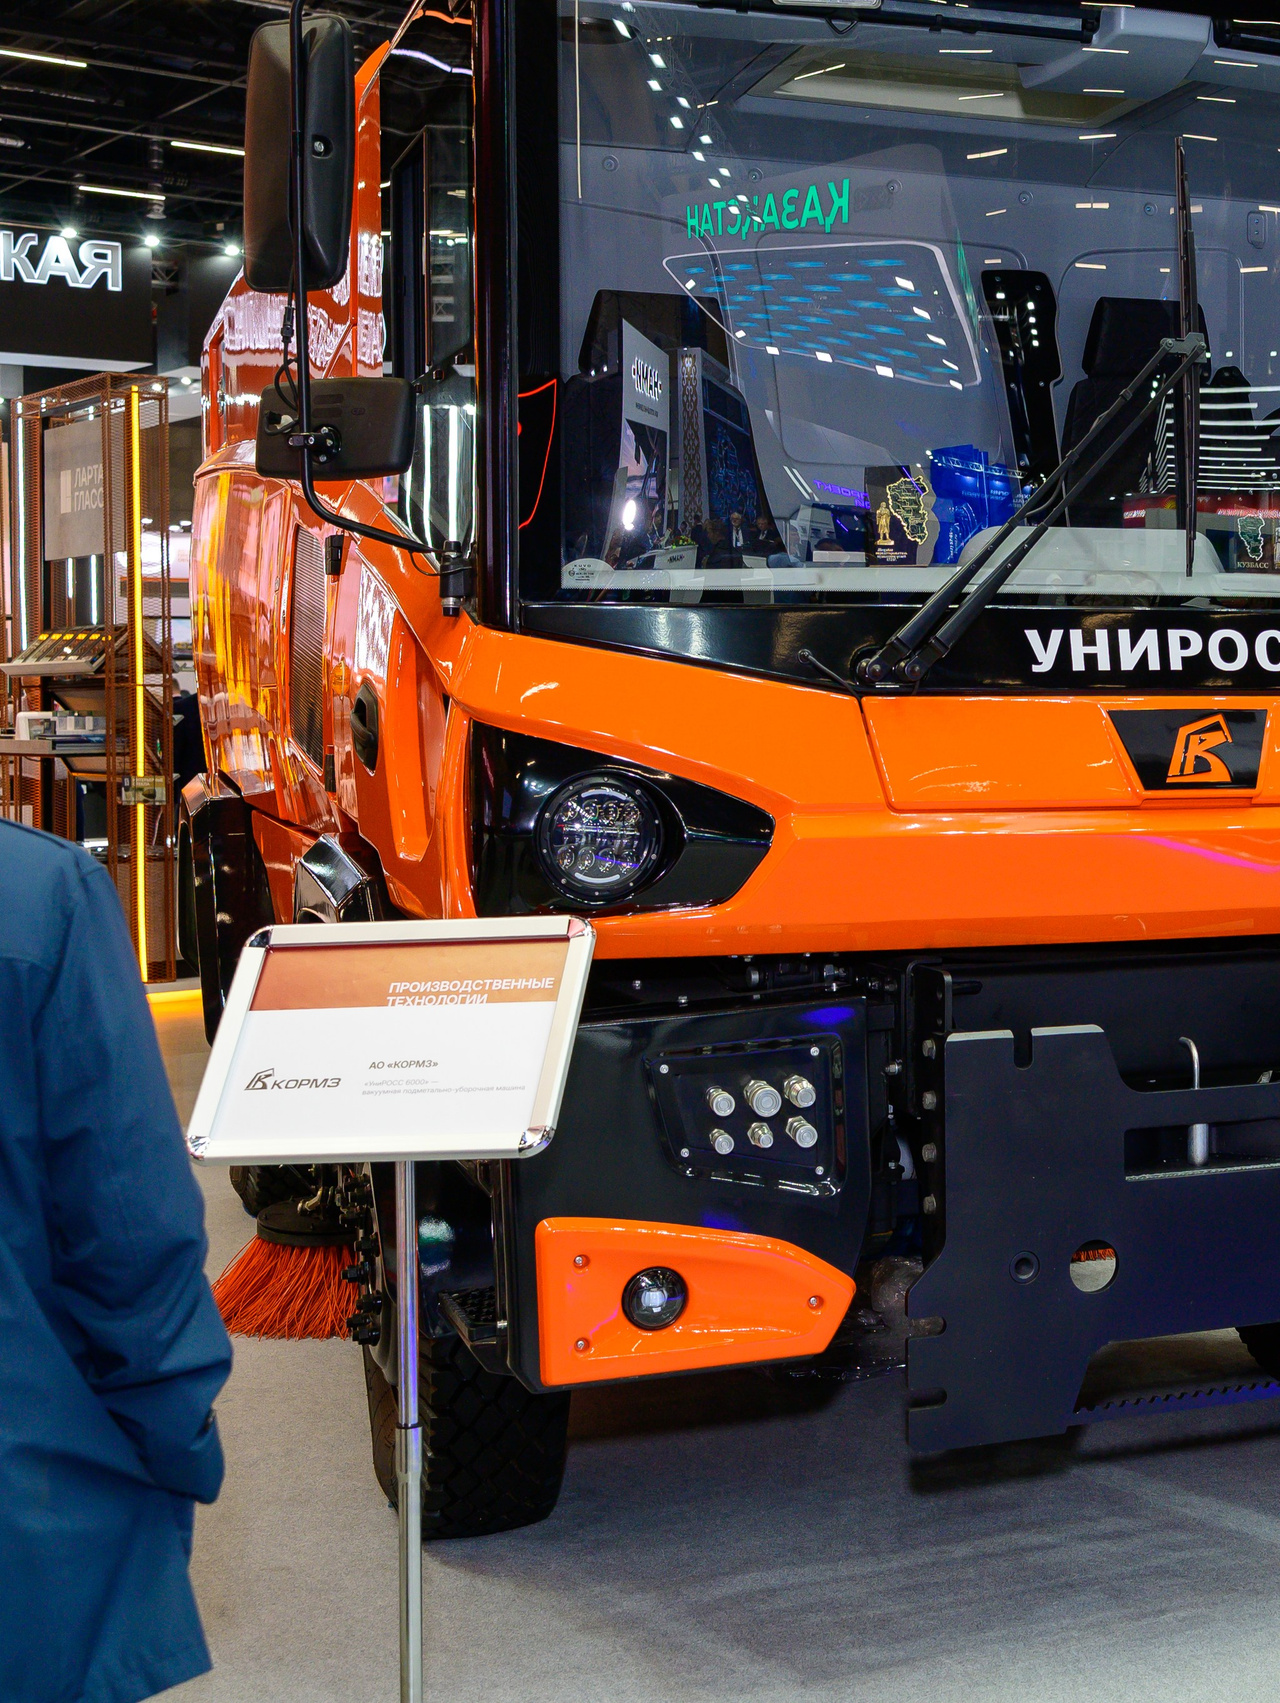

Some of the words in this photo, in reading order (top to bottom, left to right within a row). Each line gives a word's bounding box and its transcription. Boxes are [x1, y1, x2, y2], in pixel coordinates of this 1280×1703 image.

[0, 230, 122, 292] КАЯ
[1236, 561, 1269, 569] КУЗБАСС
[388, 977, 555, 994] ПРОИЗВОДСТВЕННЫЕ
[386, 993, 488, 1007] ТЕХНОЛОГИИ
[369, 1061, 385, 1070] АО
[387, 1060, 439, 1069] «КОРМЗ»
[270, 1077, 342, 1090] КОРМЗ
[403, 1085, 495, 1094] подметально-уборочная
[496, 1084, 526, 1092] машина
